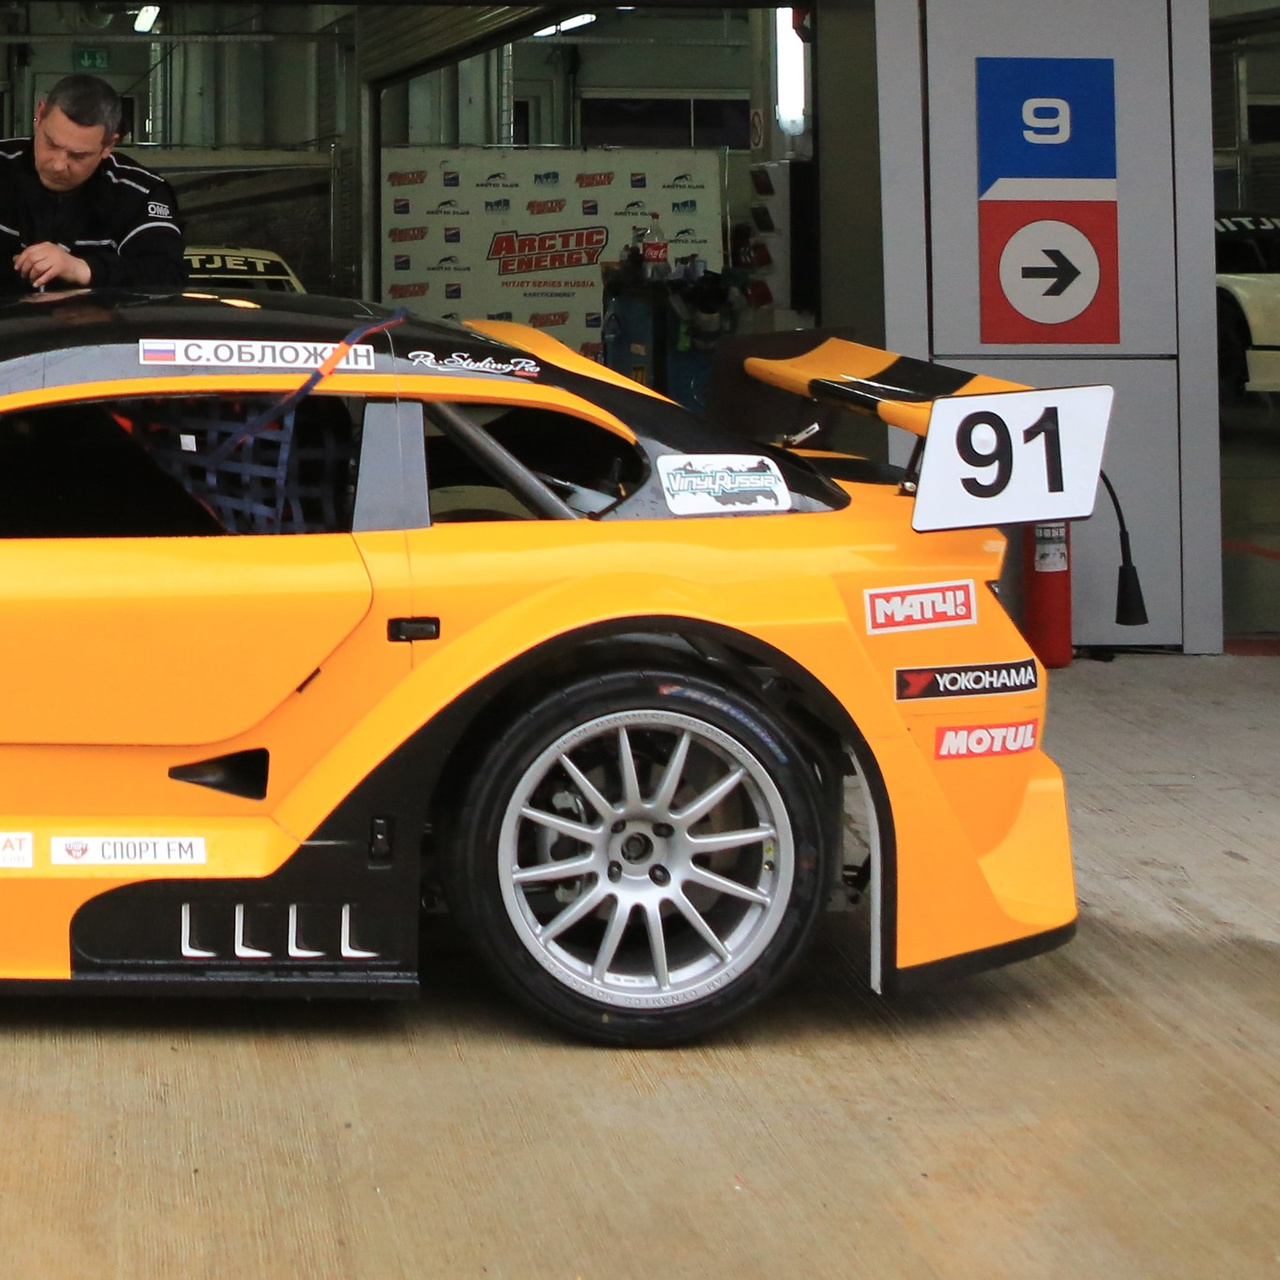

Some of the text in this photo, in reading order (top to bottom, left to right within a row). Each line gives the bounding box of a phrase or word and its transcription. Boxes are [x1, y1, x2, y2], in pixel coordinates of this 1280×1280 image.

[1022, 98, 1071, 144] 9
[147, 204, 171, 216] OMP
[490, 229, 605, 257] ARCTIC
[501, 248, 600, 273] ENERGY
[956, 406, 1064, 498] 91
[935, 666, 1036, 692] YOKOHAMA
[939, 724, 1035, 756] MOTUL
[101, 841, 194, 860] СПОРТ FM
